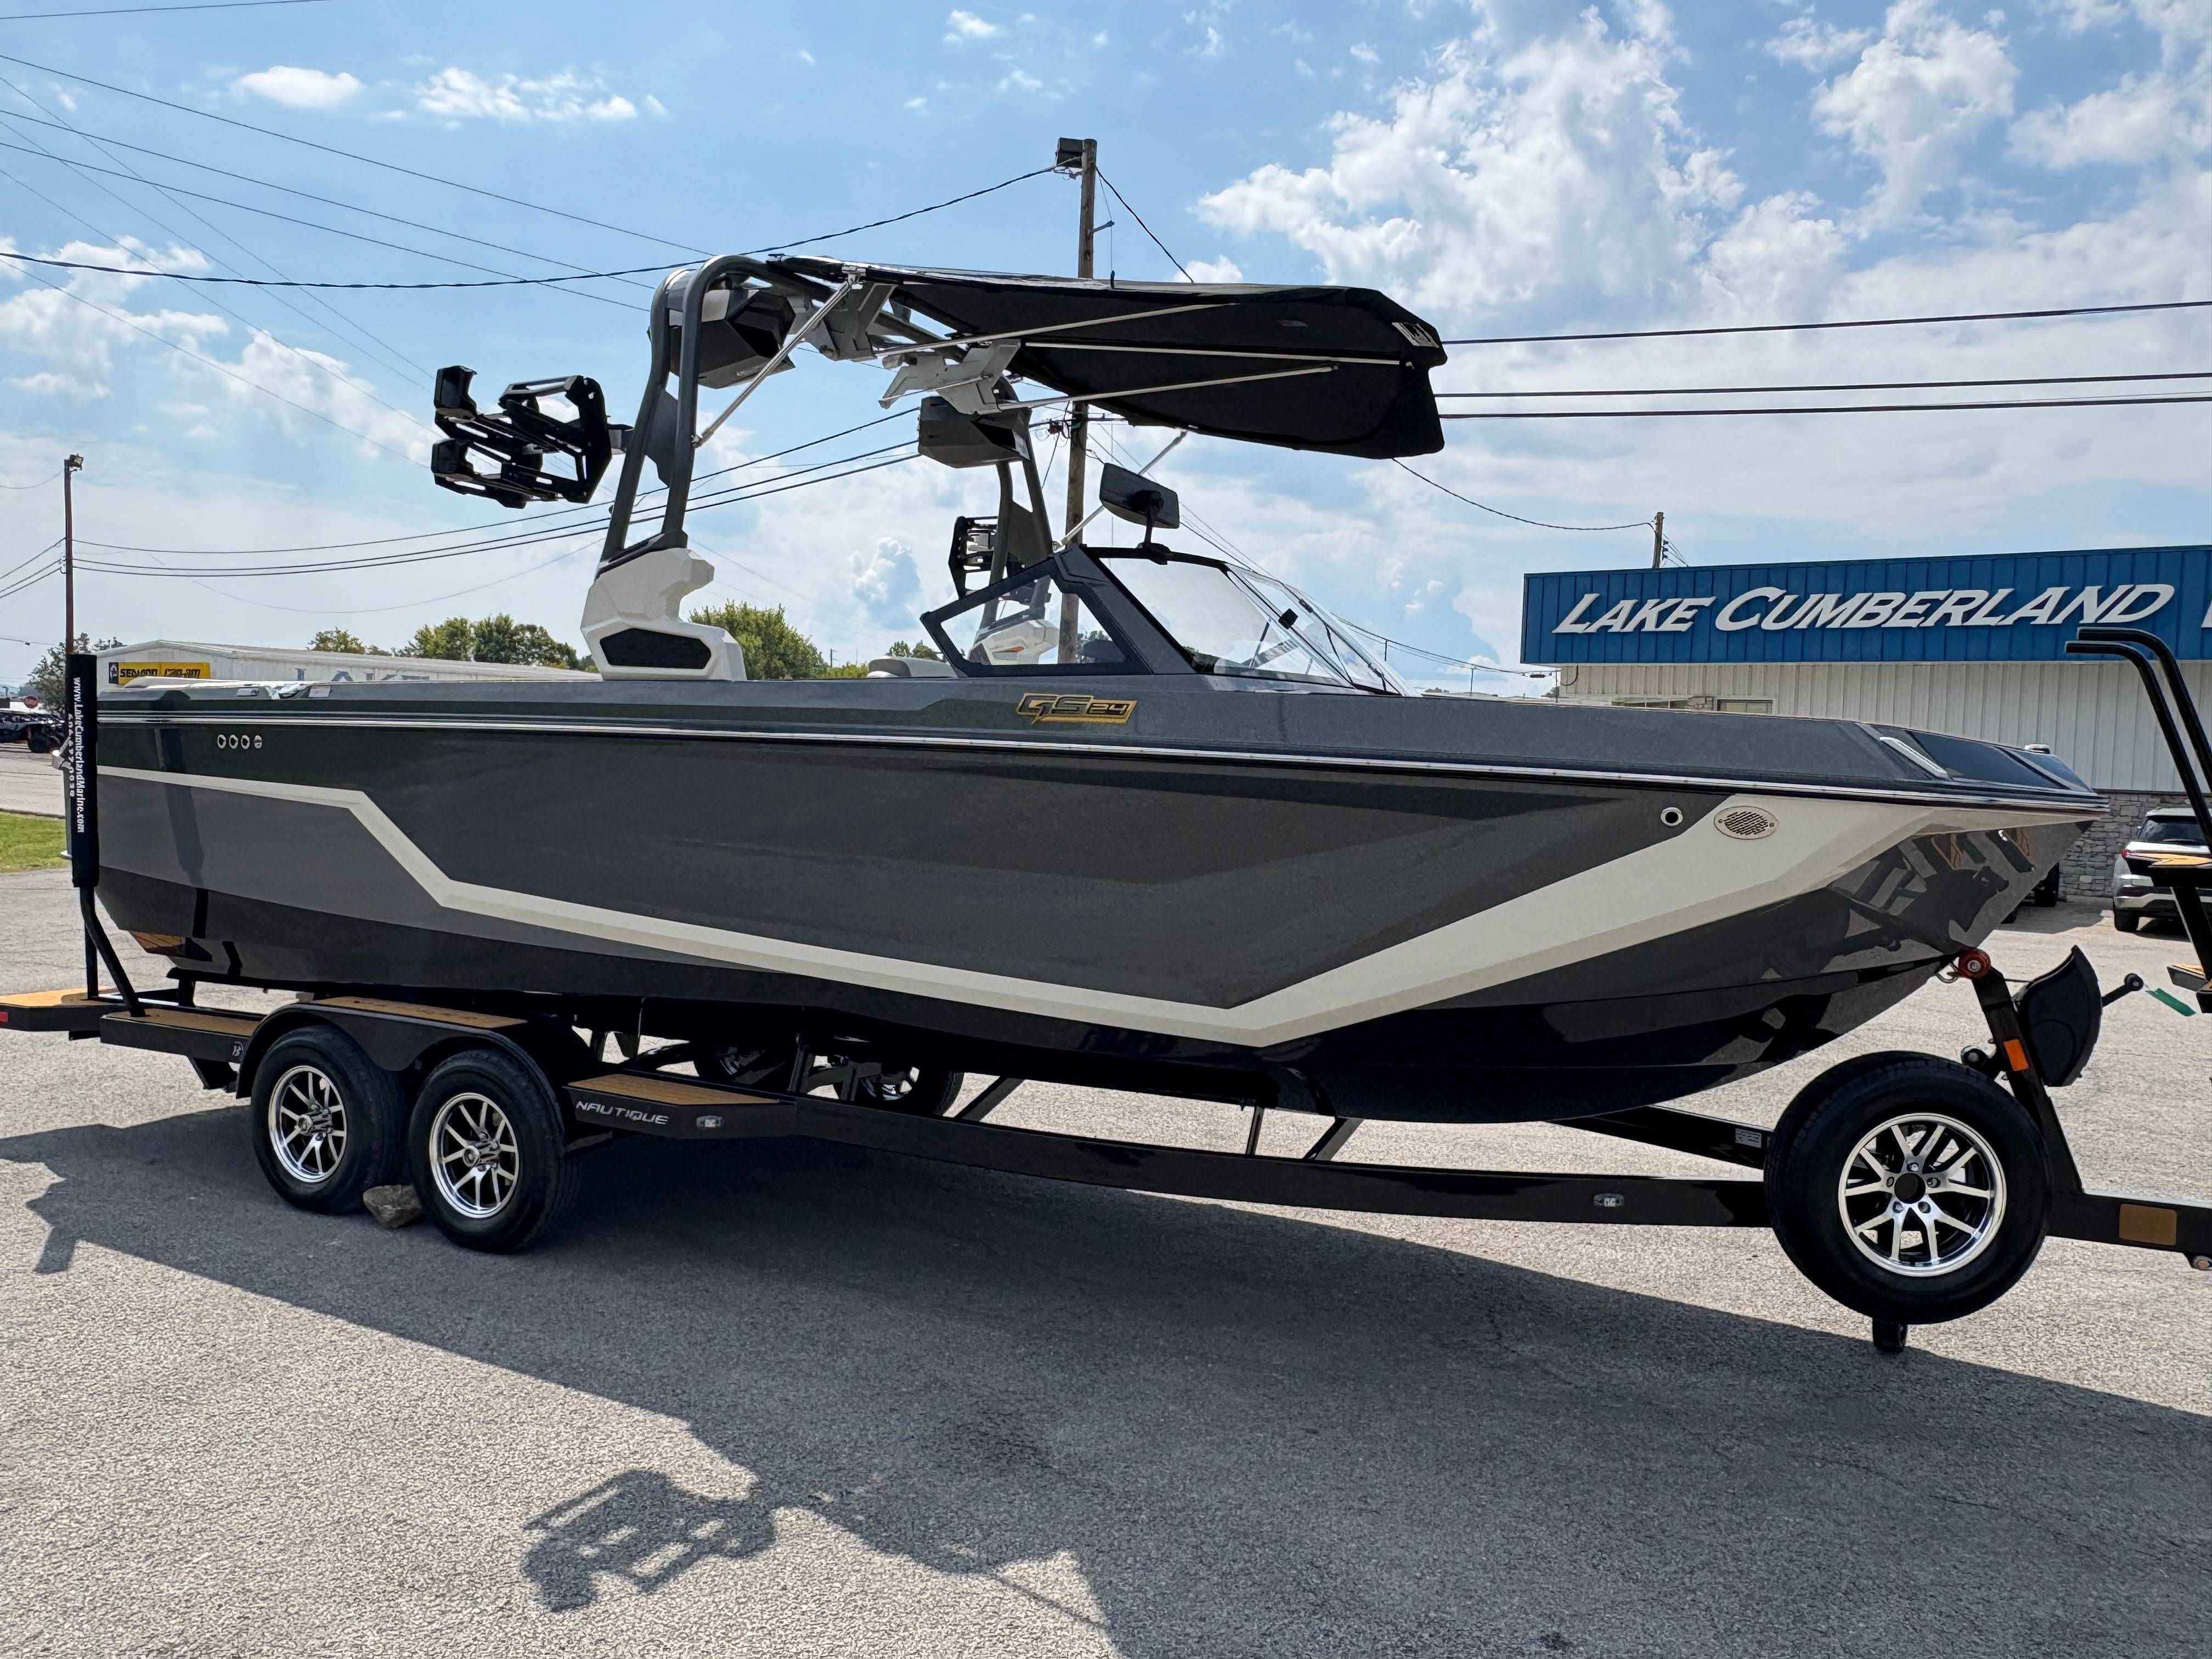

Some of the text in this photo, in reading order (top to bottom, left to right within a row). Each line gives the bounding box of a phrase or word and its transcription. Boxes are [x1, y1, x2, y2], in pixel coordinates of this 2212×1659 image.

[1551, 593, 1716, 633] LAKE
[1715, 584, 2175, 631] CUMBERLAND
[576, 1101, 669, 1125] NAUTIQUE
